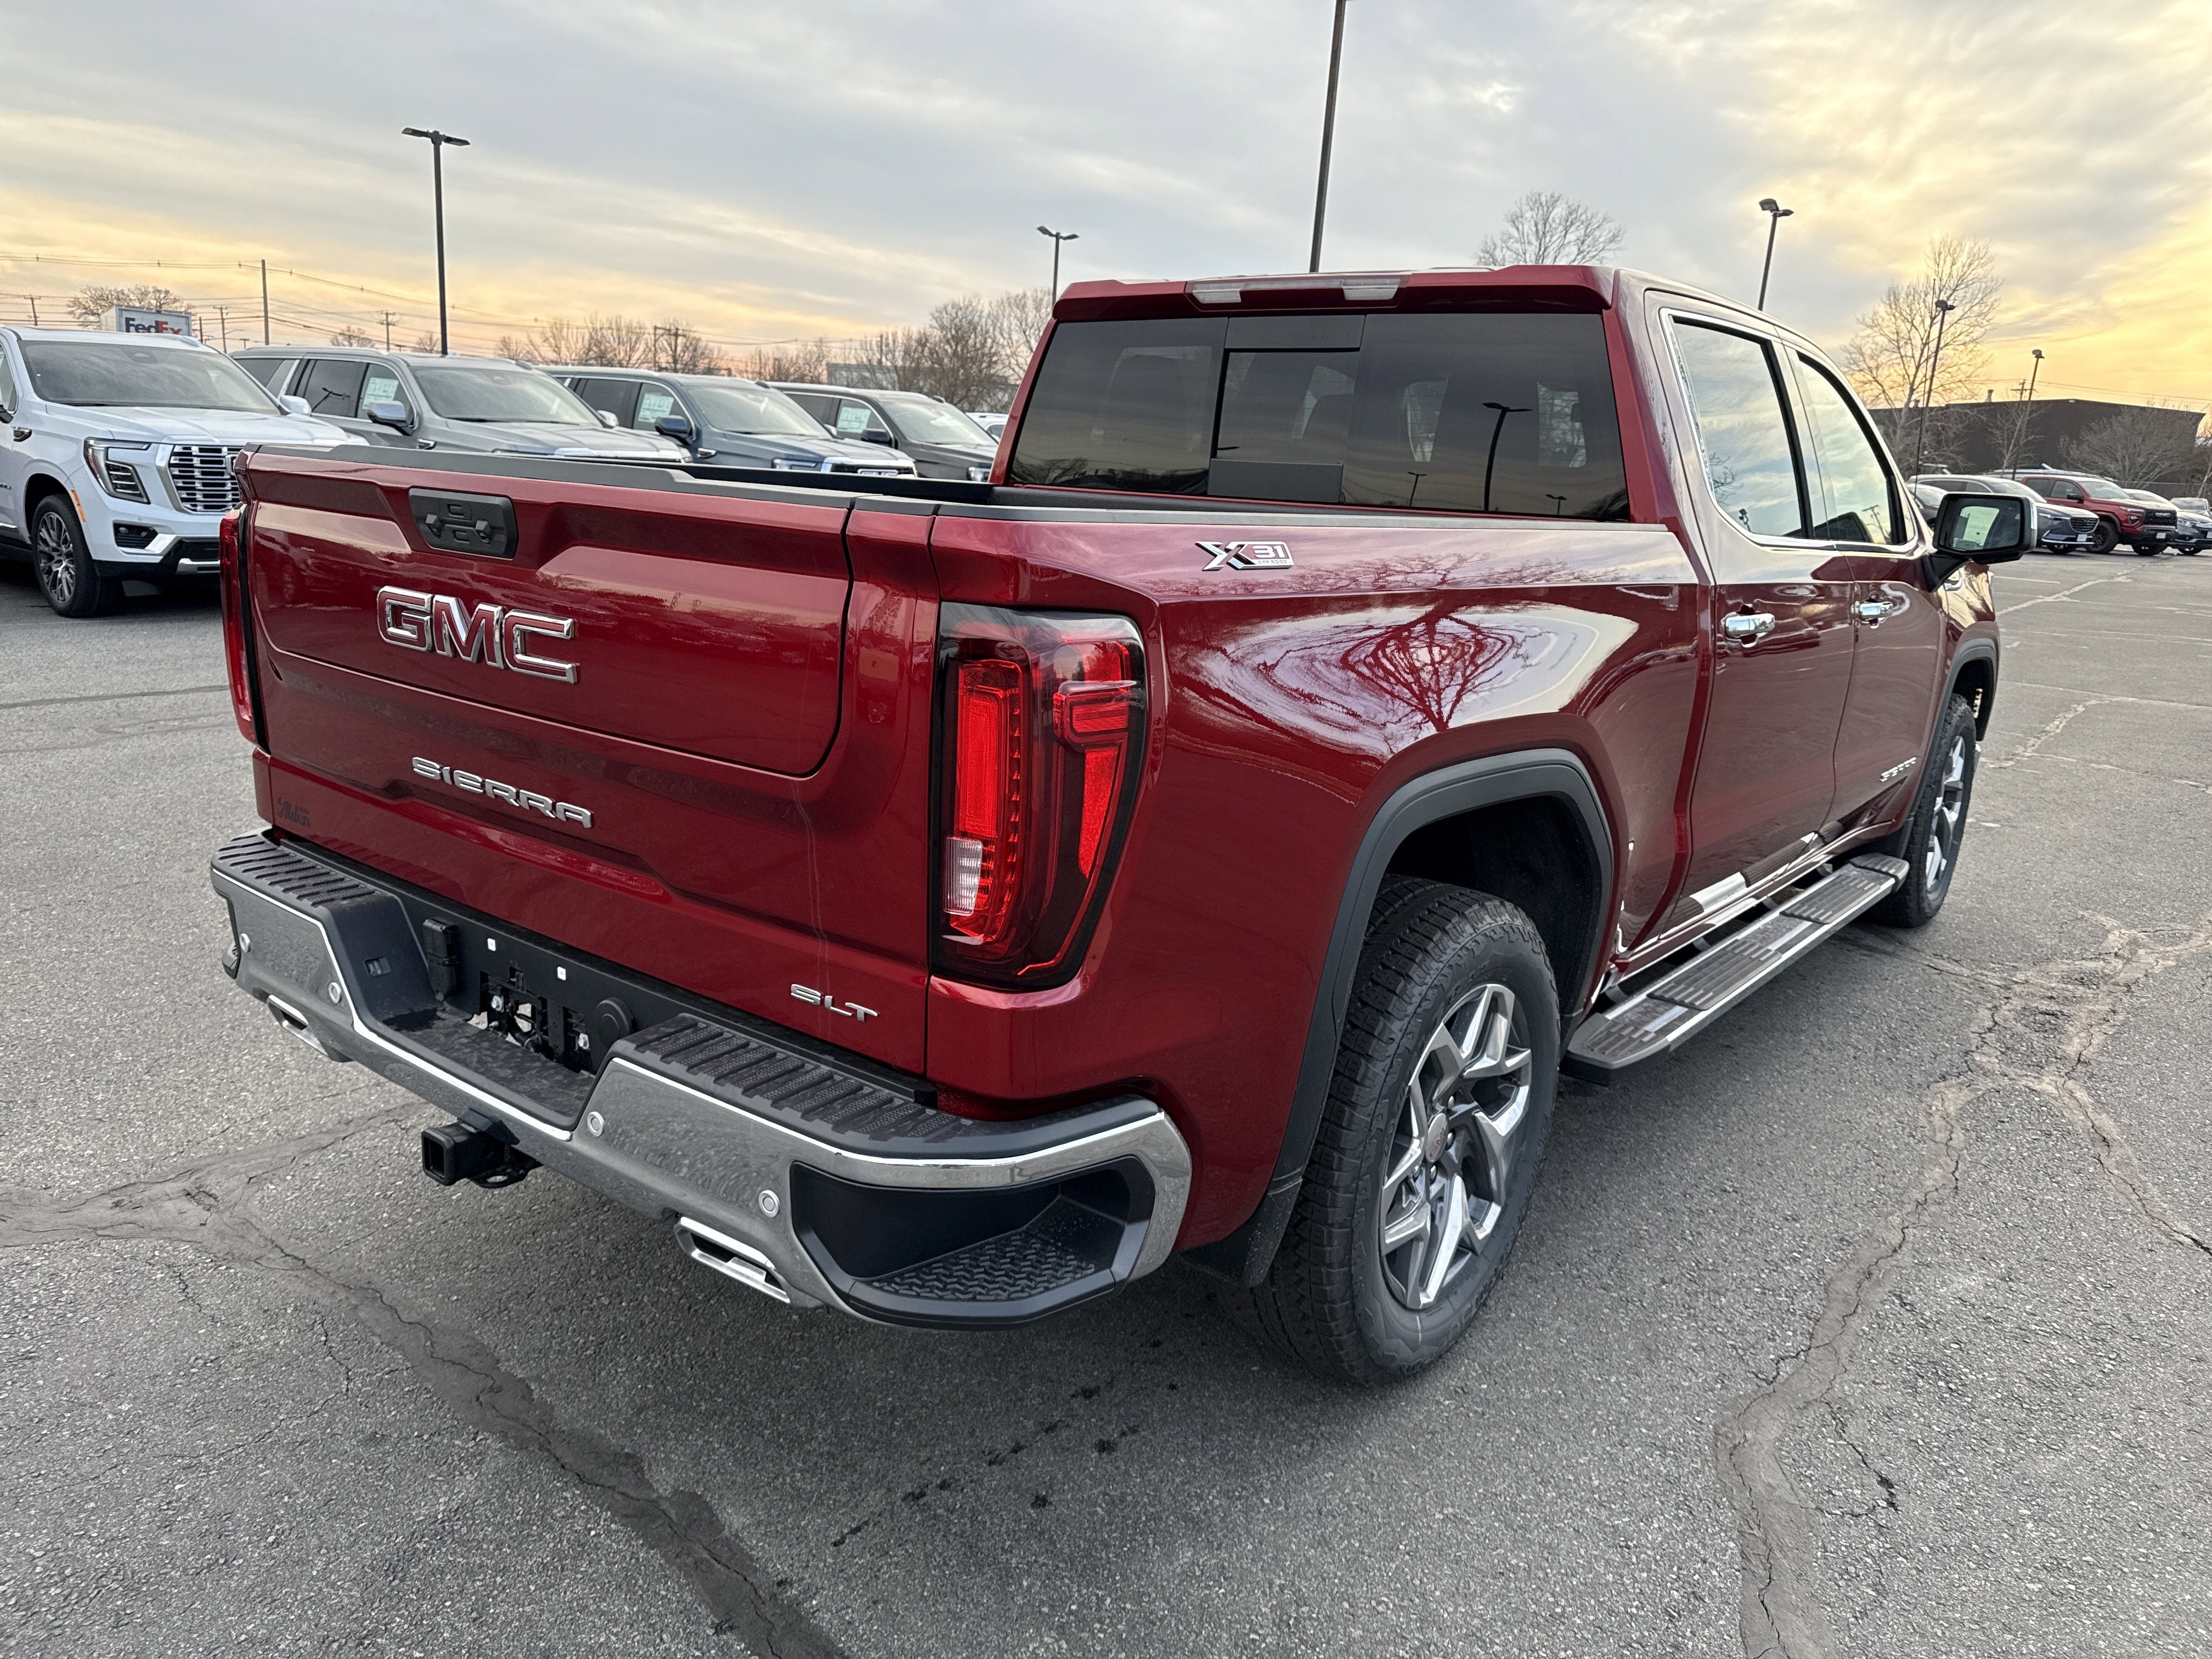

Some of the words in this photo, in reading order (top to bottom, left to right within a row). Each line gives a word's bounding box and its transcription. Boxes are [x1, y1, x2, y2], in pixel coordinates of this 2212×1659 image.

[376, 585, 579, 684] GMC
[411, 756, 594, 829] SIERRA
[791, 983, 879, 1023] SLT
